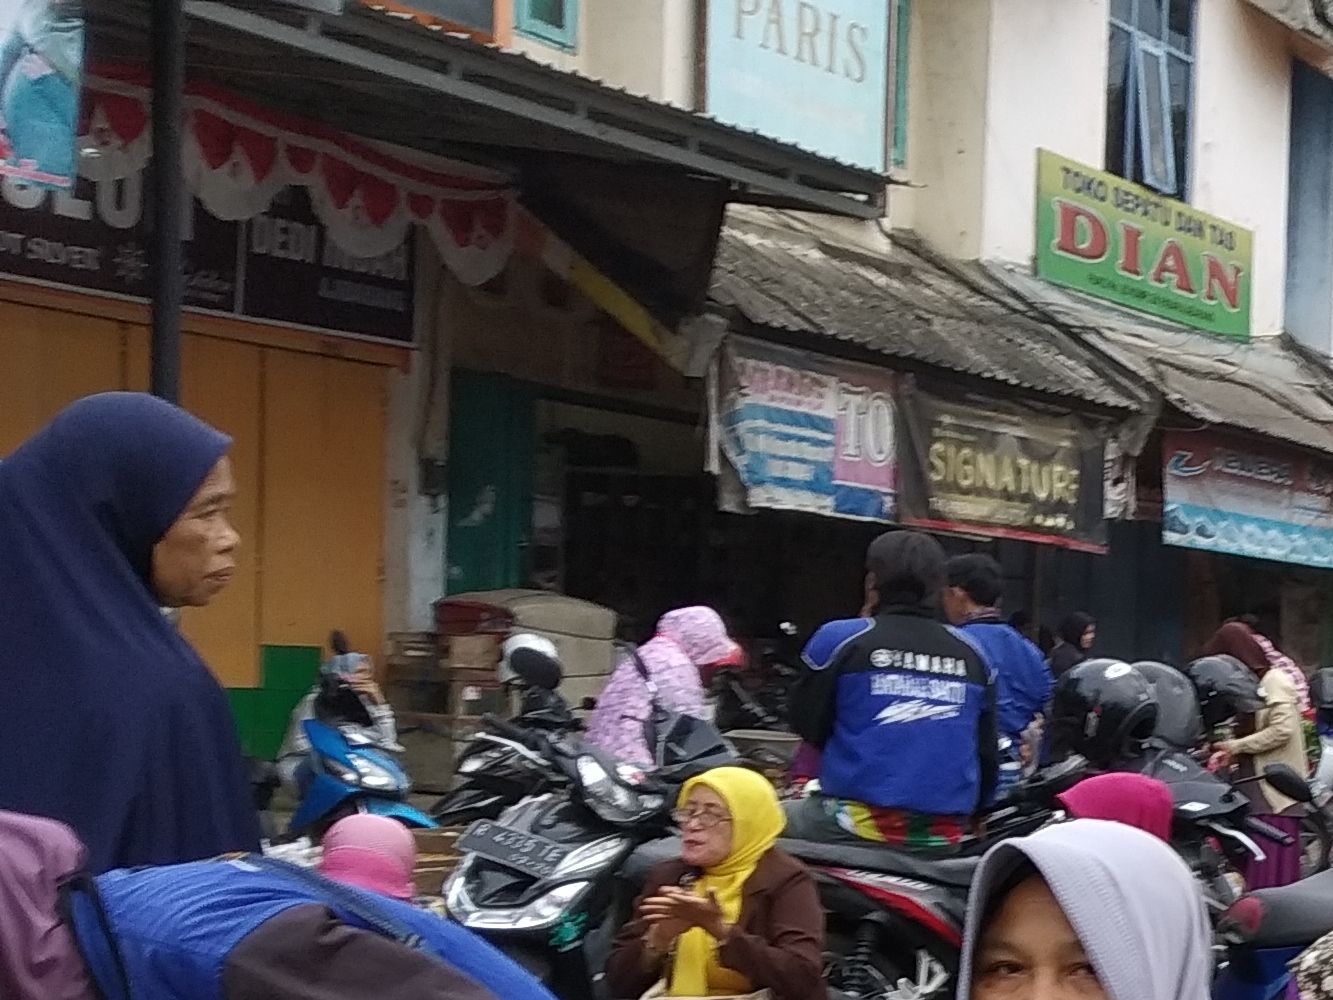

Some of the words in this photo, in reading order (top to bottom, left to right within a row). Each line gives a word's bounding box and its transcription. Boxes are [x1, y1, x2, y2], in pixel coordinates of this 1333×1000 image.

[733, 0, 869, 84] PARIS
[1060, 165, 1108, 202] TOKO
[1052, 197, 1243, 313] DIAN
[928, 440, 1080, 505] SIGNATURE
[892, 649, 968, 677] YAMAHA
